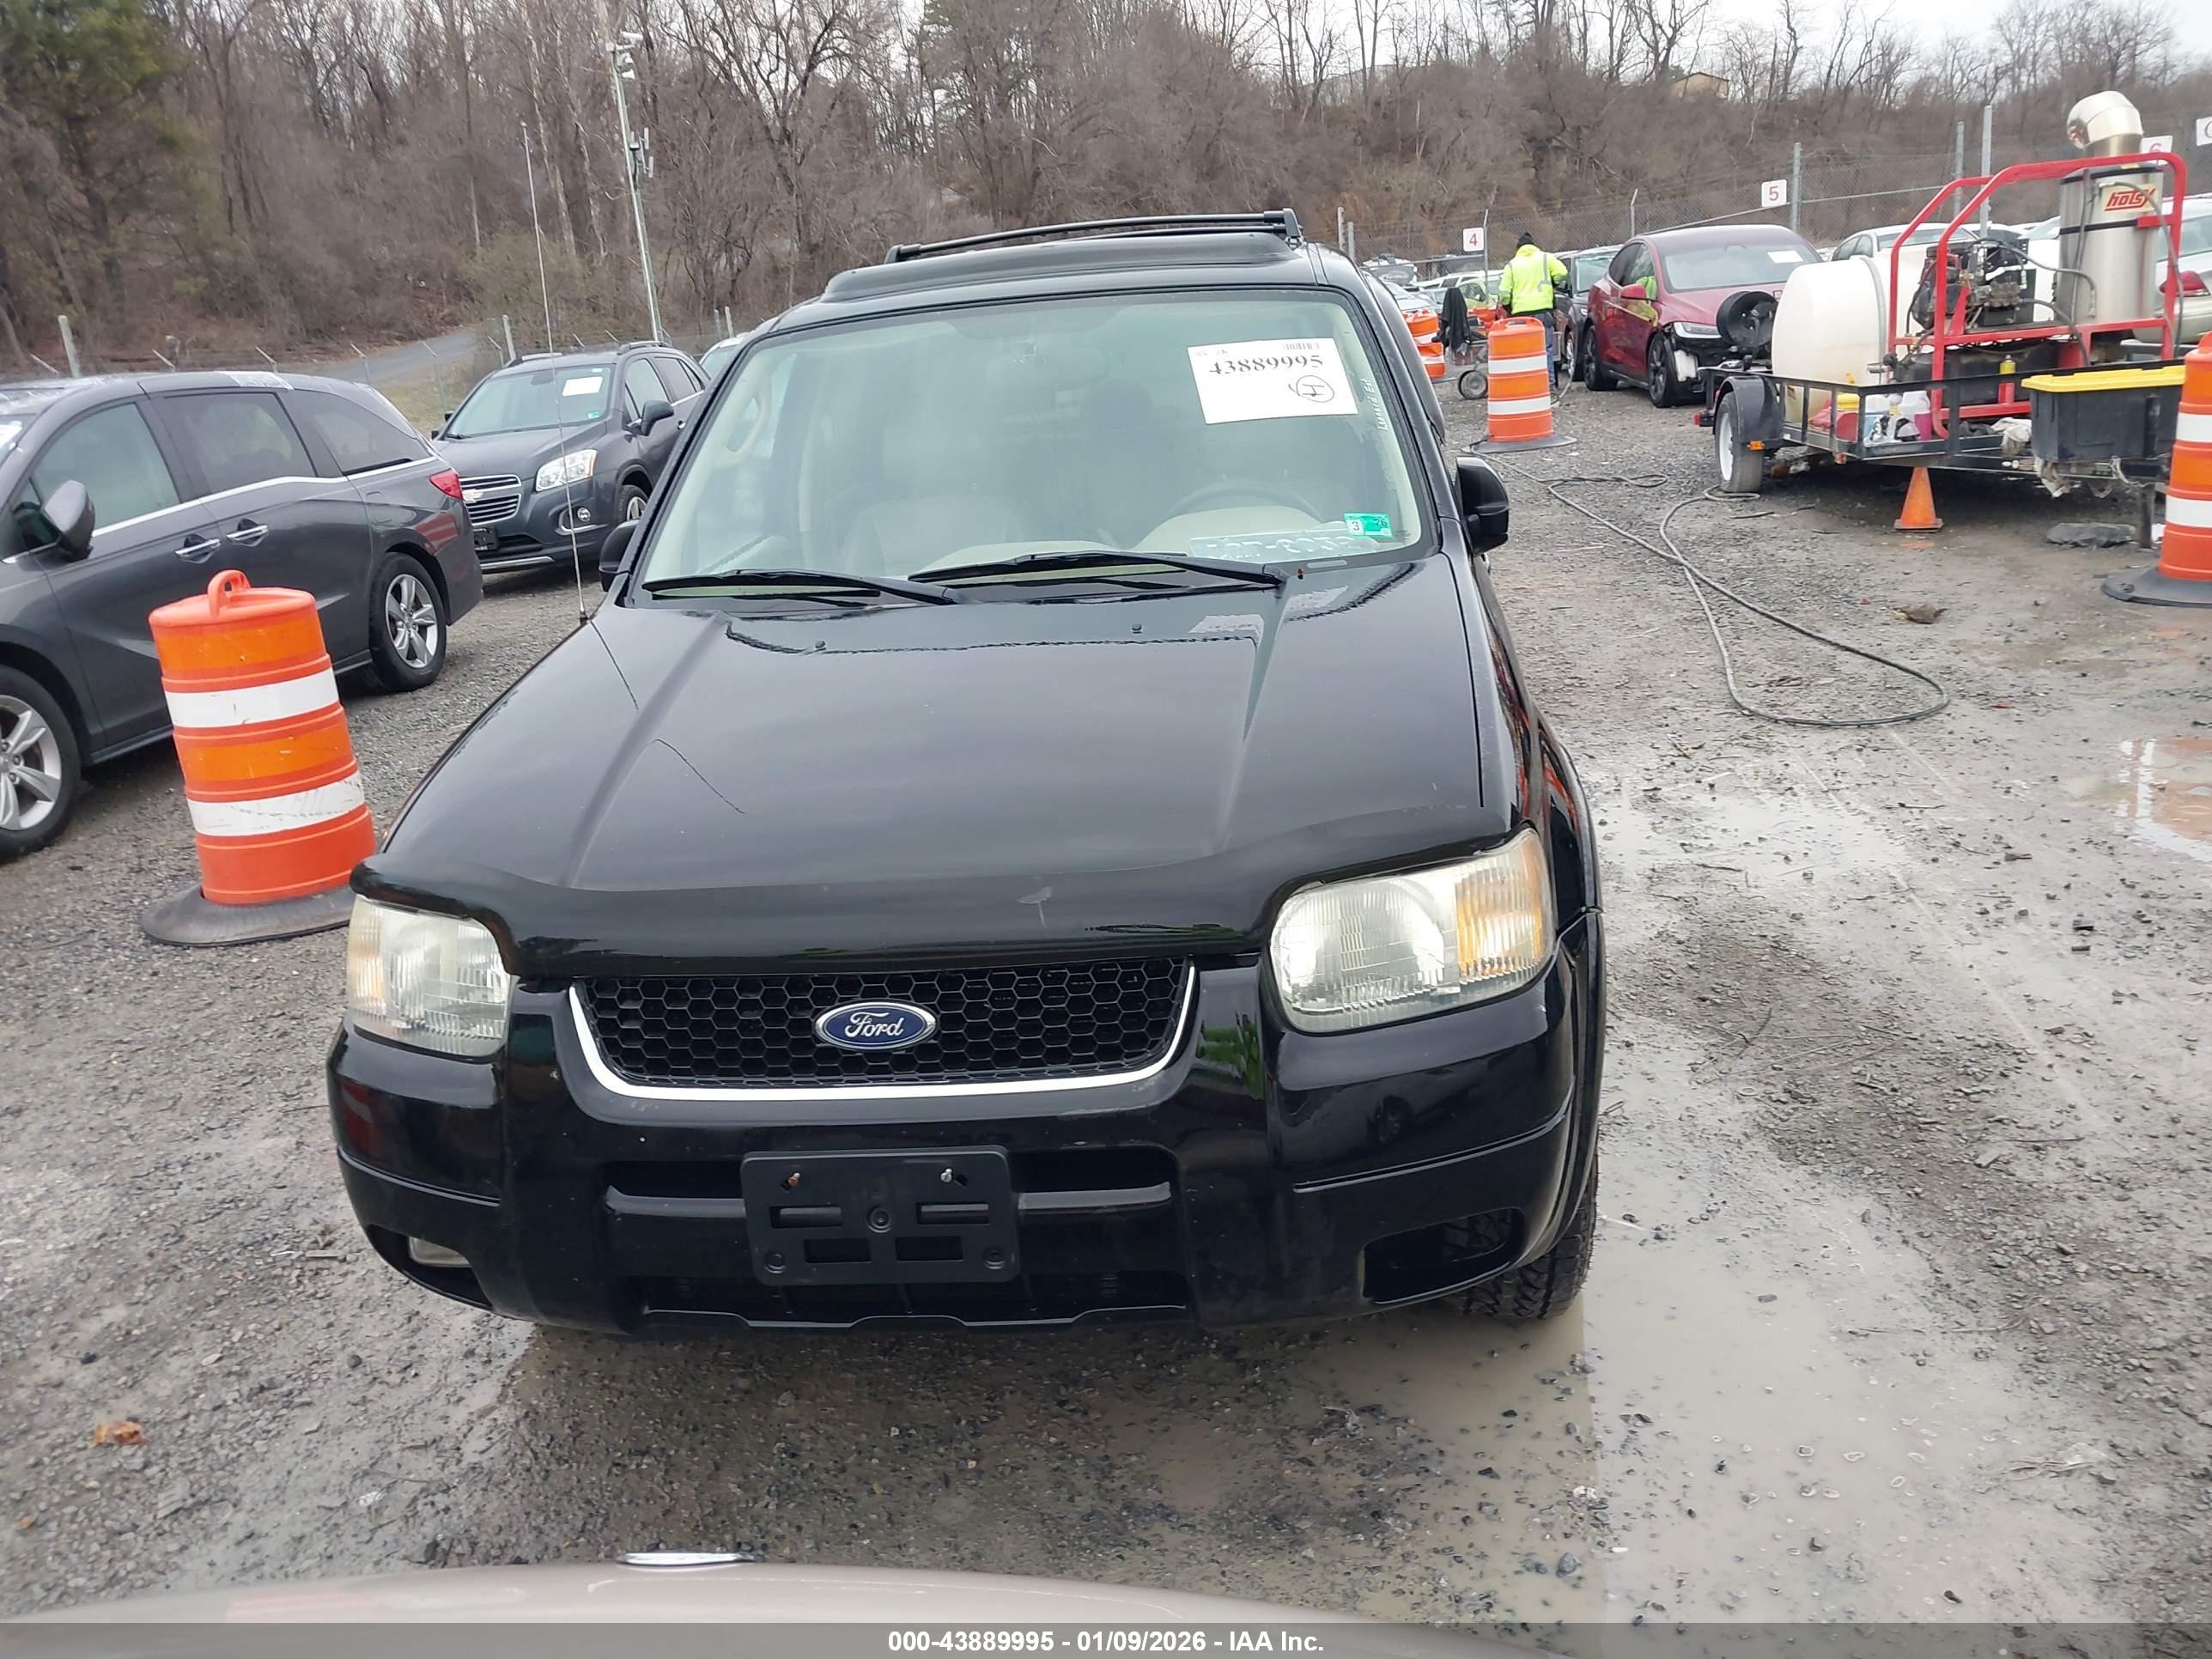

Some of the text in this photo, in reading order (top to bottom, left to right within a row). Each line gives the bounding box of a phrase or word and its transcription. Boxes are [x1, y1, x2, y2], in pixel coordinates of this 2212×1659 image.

[1769, 185, 1779, 201] 5
[1468, 233, 1478, 246] 4
[1209, 355, 1323, 375] 43889995
[1352, 521, 1359, 531] 3
[844, 1012, 905, 1038] Ford
